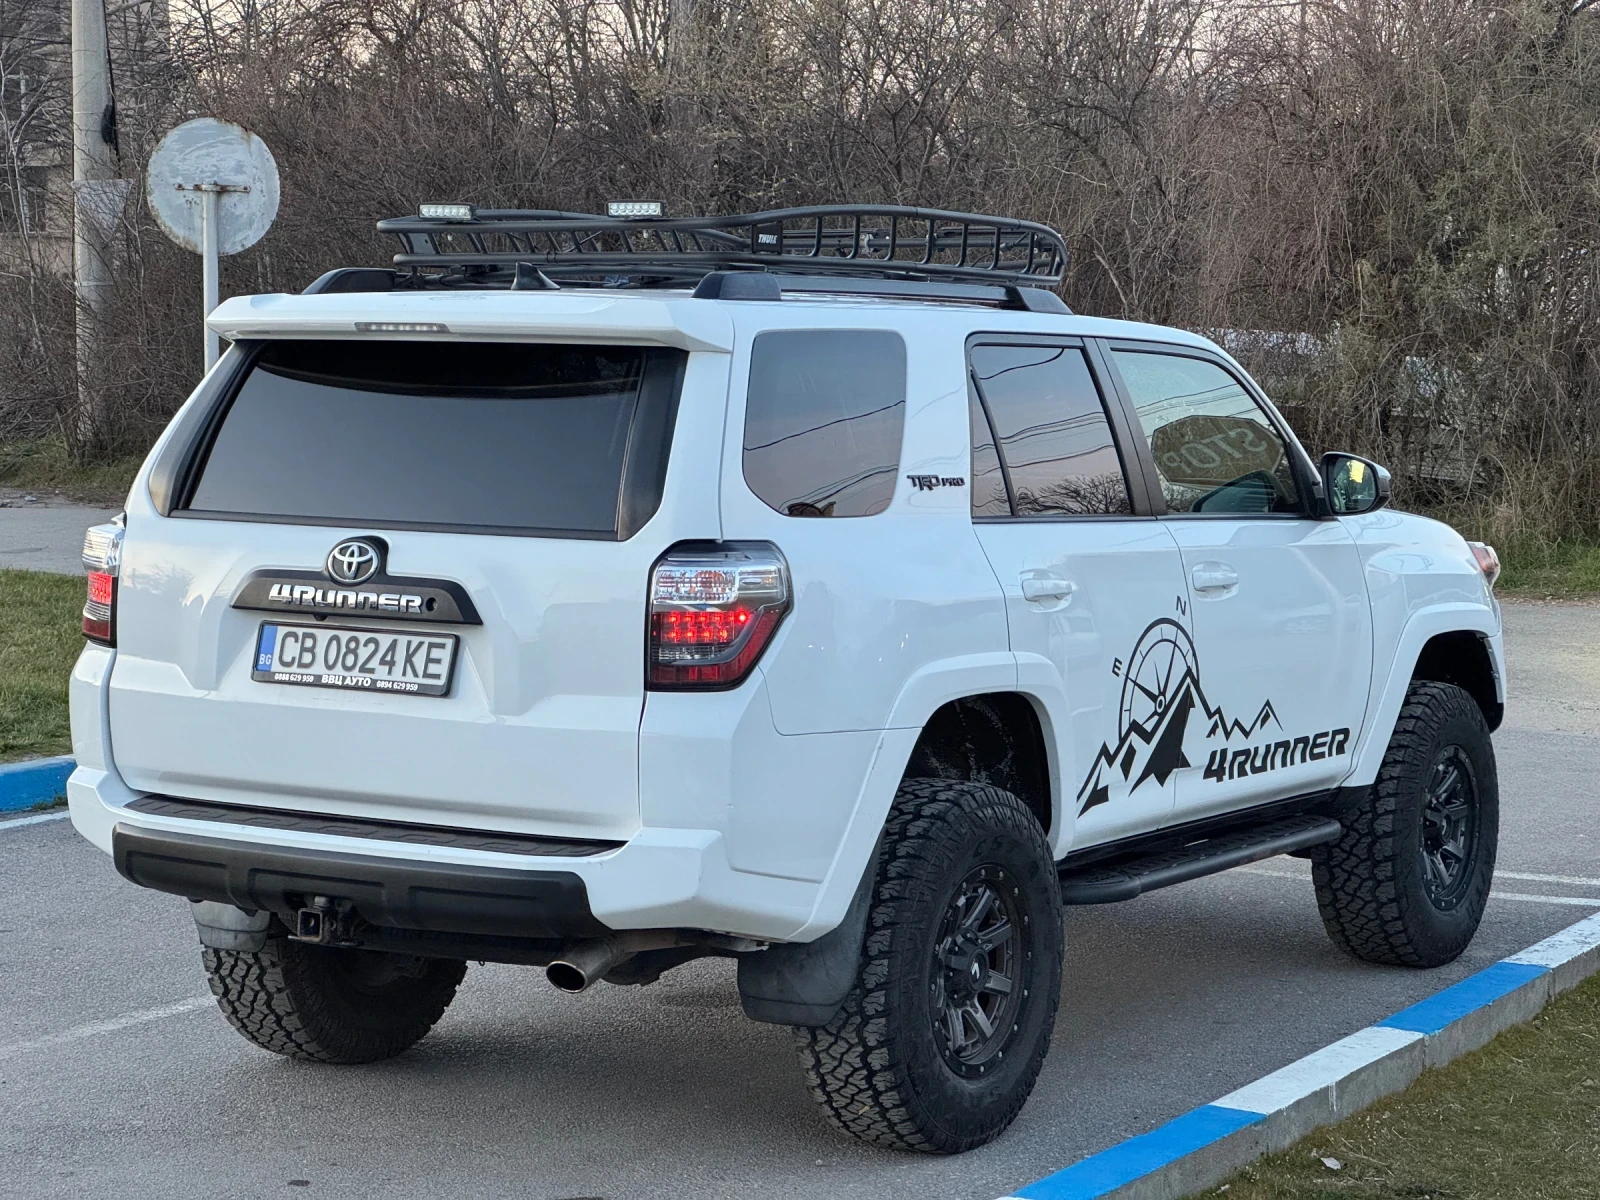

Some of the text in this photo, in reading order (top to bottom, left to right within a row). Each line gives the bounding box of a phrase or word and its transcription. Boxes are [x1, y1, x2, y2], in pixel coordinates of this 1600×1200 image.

[758, 234, 778, 244] THULE
[906, 474, 965, 491] TRD PRO
[269, 583, 422, 613] 4RUNNER
[1175, 595, 1187, 616] N
[258, 653, 272, 666] BG
[278, 631, 446, 680] CB 0824 KE
[1111, 657, 1123, 678] E
[290, 674, 302, 682] 629
[393, 682, 405, 690] 629
[1202, 727, 1350, 783] 4RUNNER
